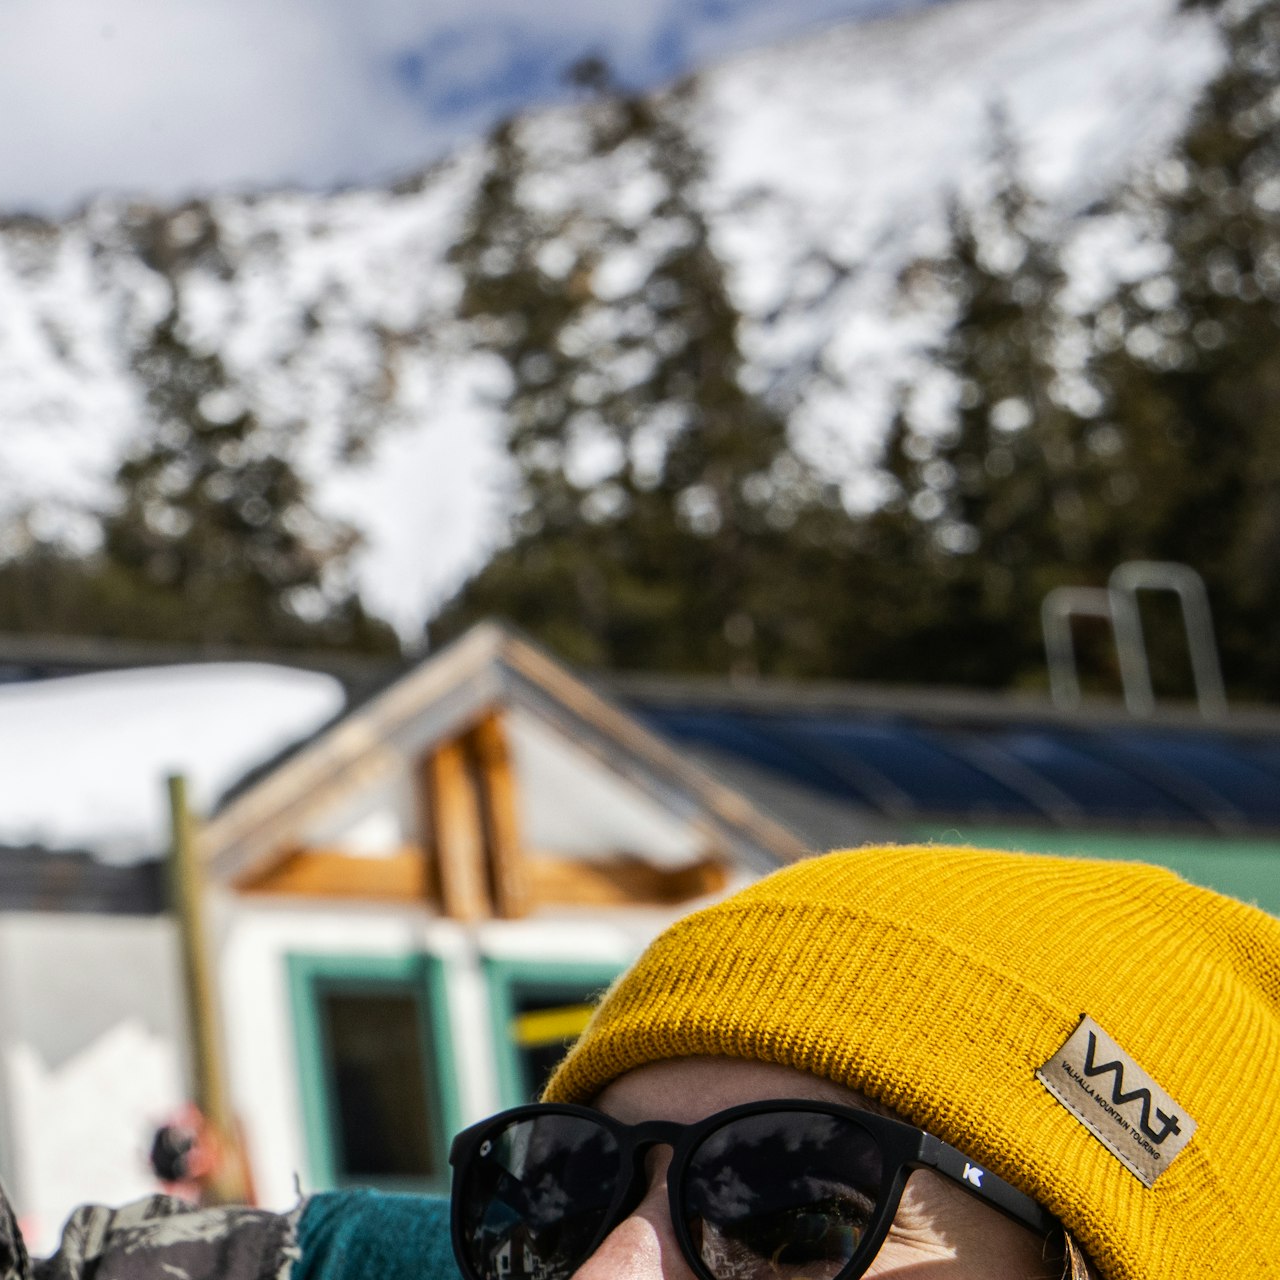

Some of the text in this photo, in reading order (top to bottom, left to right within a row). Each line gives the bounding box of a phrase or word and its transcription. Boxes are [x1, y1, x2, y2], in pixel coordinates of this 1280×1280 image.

[1061, 1060, 1161, 1161] VALHALLA MOUNTAIN TOURING
